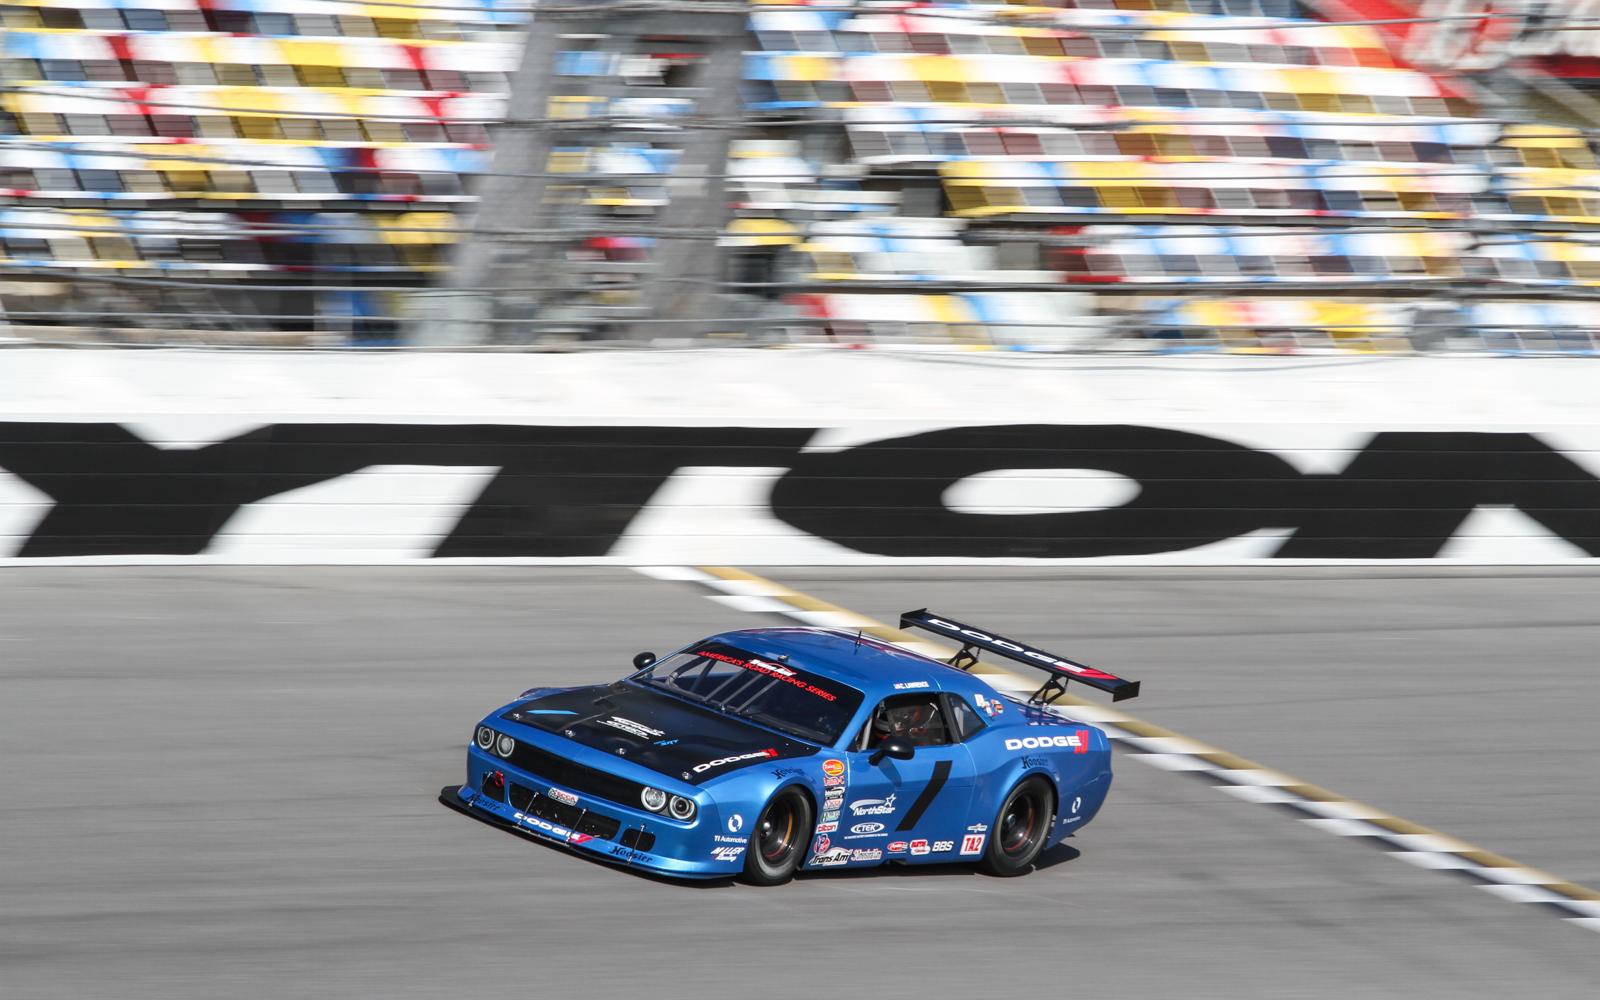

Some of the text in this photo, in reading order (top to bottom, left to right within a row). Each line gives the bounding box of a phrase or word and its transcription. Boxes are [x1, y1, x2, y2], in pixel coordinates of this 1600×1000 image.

[928, 617, 1087, 674] DODGE
[743, 662, 772, 675] ROAD
[769, 671, 807, 689] RACING
[805, 684, 837, 702] SERIES
[1004, 734, 1082, 751] DODGE
[692, 751, 771, 774] DODGE
[853, 805, 896, 817] NorthStar
[513, 812, 580, 840] DODGE
[856, 824, 876, 832] CTEK
[720, 835, 748, 844] Automotive
[931, 841, 955, 852] BBS
[964, 836, 983, 852] TA2
[608, 845, 653, 862] Hoosier
[813, 854, 833, 864] Trans
[833, 851, 849, 862] Am
